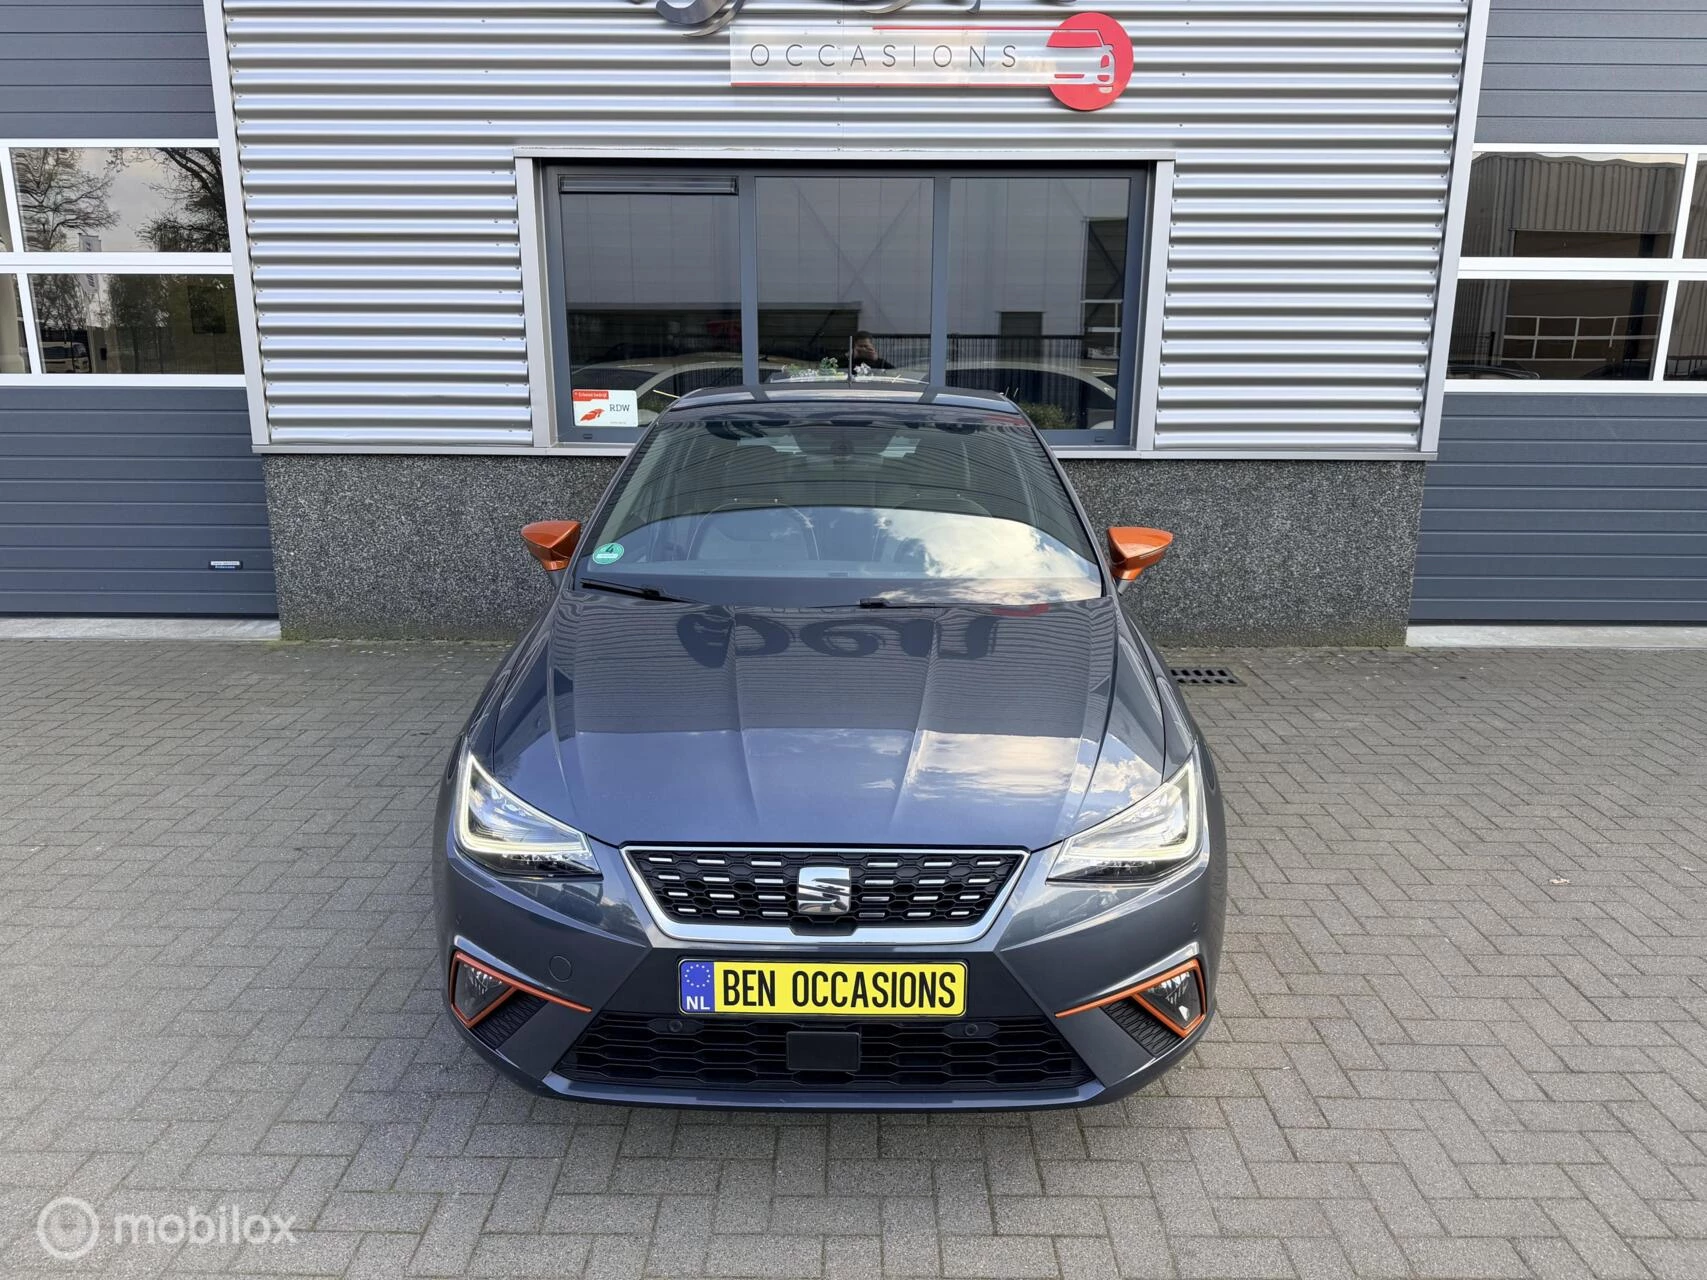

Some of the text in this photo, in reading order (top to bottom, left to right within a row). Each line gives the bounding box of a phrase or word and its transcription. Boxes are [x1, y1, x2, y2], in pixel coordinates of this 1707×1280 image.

[750, 44, 1017, 67] OCCASIONS
[609, 404, 630, 412] RDW
[722, 970, 956, 1008] BEN OCCASIONS
[686, 996, 710, 1011] NL
